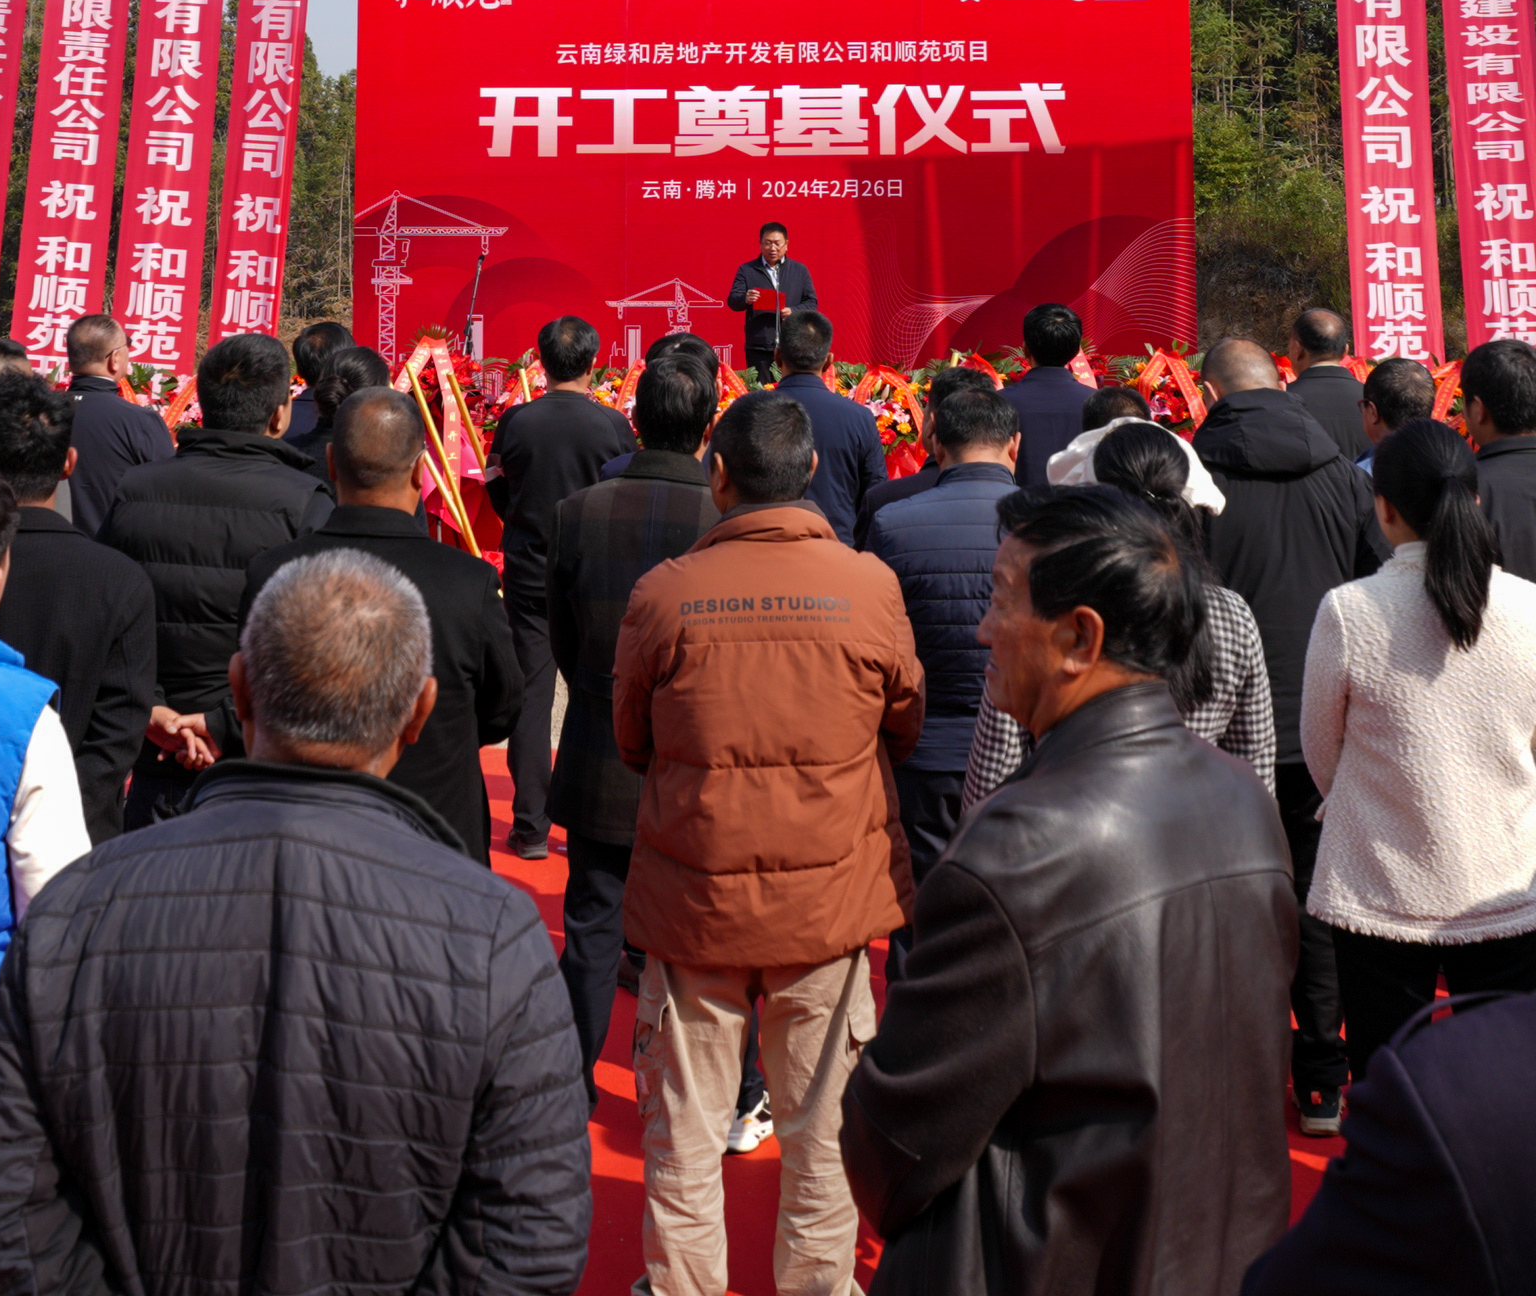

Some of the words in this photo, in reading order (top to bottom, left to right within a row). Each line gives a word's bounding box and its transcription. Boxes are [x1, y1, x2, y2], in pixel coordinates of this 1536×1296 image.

[555, 40, 989, 65] 云南绿和房地产开发有限公司和顺苑项目
[478, 82, 1067, 157] 开工奠基仪式
[762, 178, 904, 198] 2024年2月26日
[680, 597, 755, 616] DESIGN
[681, 617, 715, 627] DESIGN
[718, 616, 754, 624] STUDIO
[757, 615, 794, 623] TRENDY
[796, 614, 822, 622] MENS
[824, 615, 851, 623] WEAR
